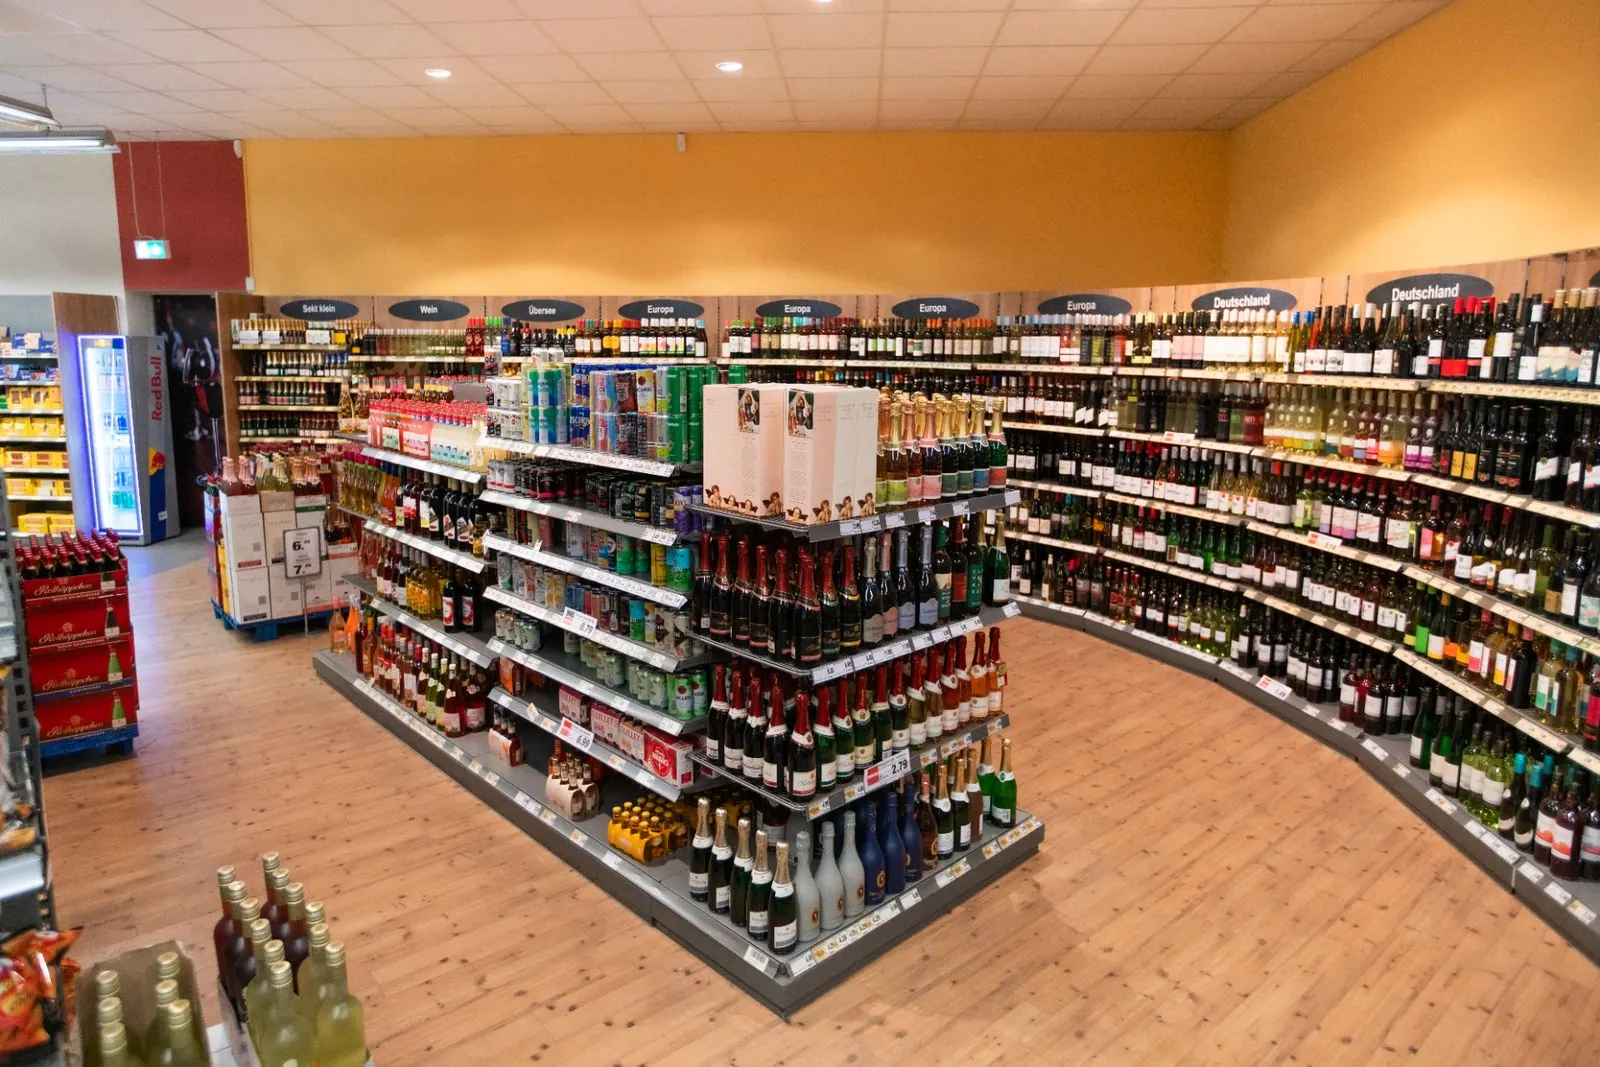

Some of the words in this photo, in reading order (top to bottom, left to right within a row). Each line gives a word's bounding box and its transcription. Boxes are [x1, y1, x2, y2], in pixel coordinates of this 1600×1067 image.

[1391, 282, 1460, 302] Deutschland
[1067, 301, 1096, 312] Europa
[1213, 293, 1271, 309] Deutschland
[302, 304, 318, 313] Sekt
[319, 304, 336, 313] klein
[420, 305, 438, 314] Wein
[528, 304, 557, 315] Übersee
[647, 305, 675, 315] Europa
[784, 304, 811, 315] Europa
[919, 303, 947, 315] Europa
[150, 356, 162, 386] Bull
[151, 390, 162, 421] Red
[576, 735, 591, 748] 6.99
[891, 759, 908, 775] 2.79
